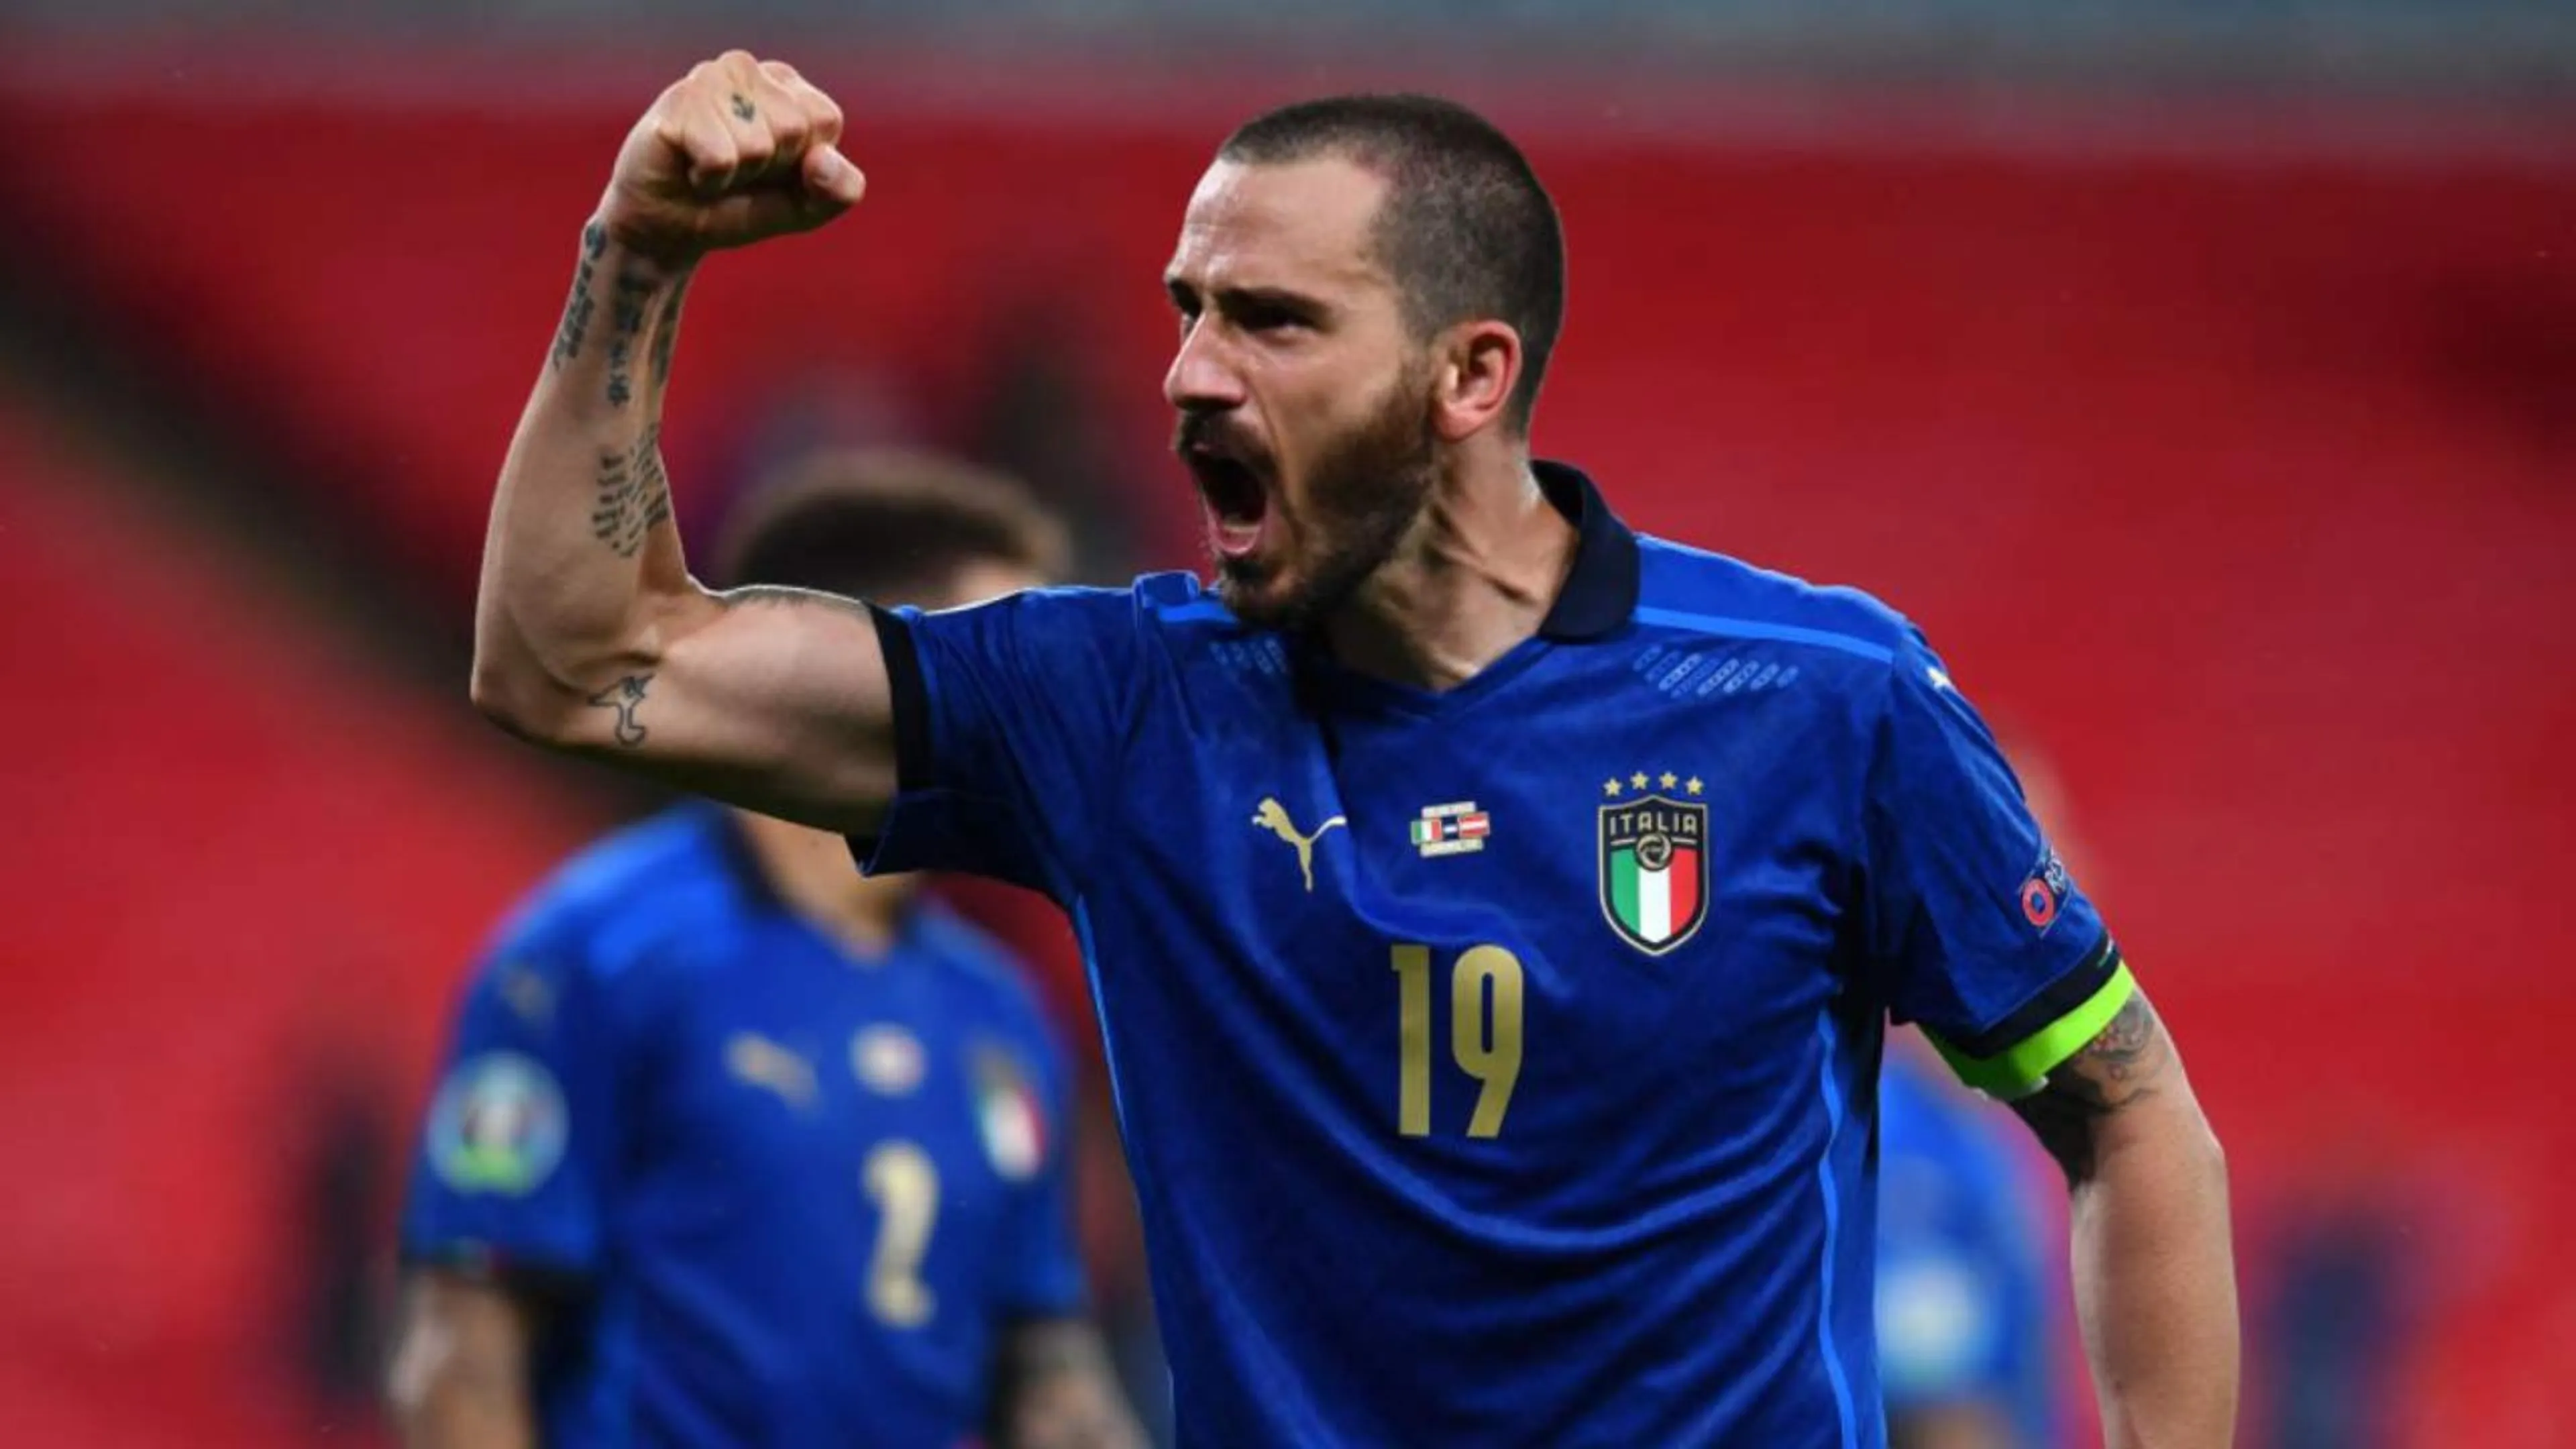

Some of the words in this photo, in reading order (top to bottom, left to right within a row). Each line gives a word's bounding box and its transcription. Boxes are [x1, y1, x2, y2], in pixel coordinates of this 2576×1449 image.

[1609, 811, 1698, 836] ITALIA
[1391, 945, 1523, 1138] 19
[861, 1139, 941, 1328] 2
